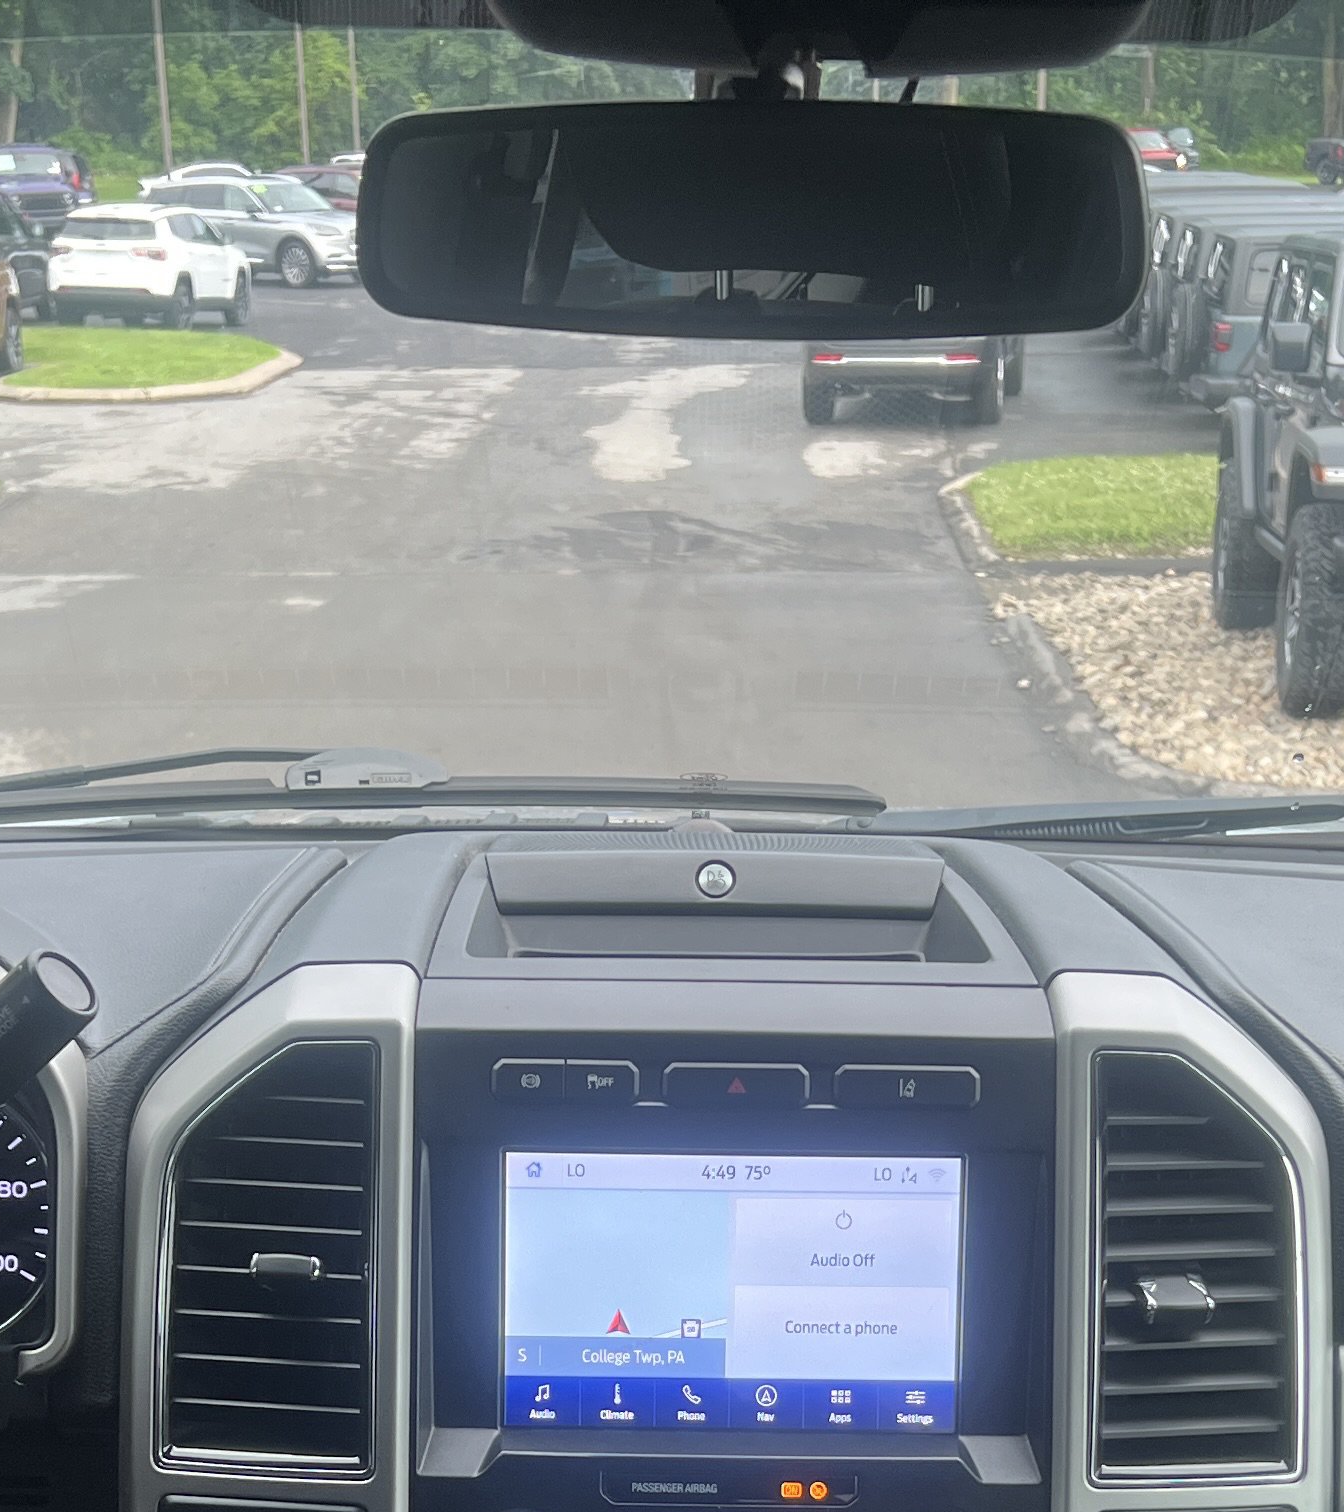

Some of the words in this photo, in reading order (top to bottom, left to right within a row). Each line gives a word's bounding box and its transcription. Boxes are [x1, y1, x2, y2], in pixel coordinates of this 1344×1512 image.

[566, 1163, 586, 1178] LO
[701, 1164, 736, 1181] 4:49
[873, 1167, 893, 1182] LO
[811, 1252, 850, 1268] Audio
[853, 1252, 876, 1268] Off
[784, 1319, 840, 1335] Connect
[843, 1323, 852, 1335] a
[854, 1320, 898, 1338] phone
[517, 1349, 527, 1363] S
[581, 1348, 631, 1367] College
[633, 1349, 665, 1367] Twp,
[667, 1349, 685, 1365] PA
[529, 1409, 556, 1421] Audio
[599, 1409, 635, 1421] Climate
[677, 1410, 706, 1422] Phone
[757, 1411, 775, 1422] Nav
[828, 1413, 852, 1425] Apps
[896, 1412, 934, 1426] Settings
[631, 1482, 683, 1494] PASSENGER
[684, 1482, 718, 1494] AIRBAG
